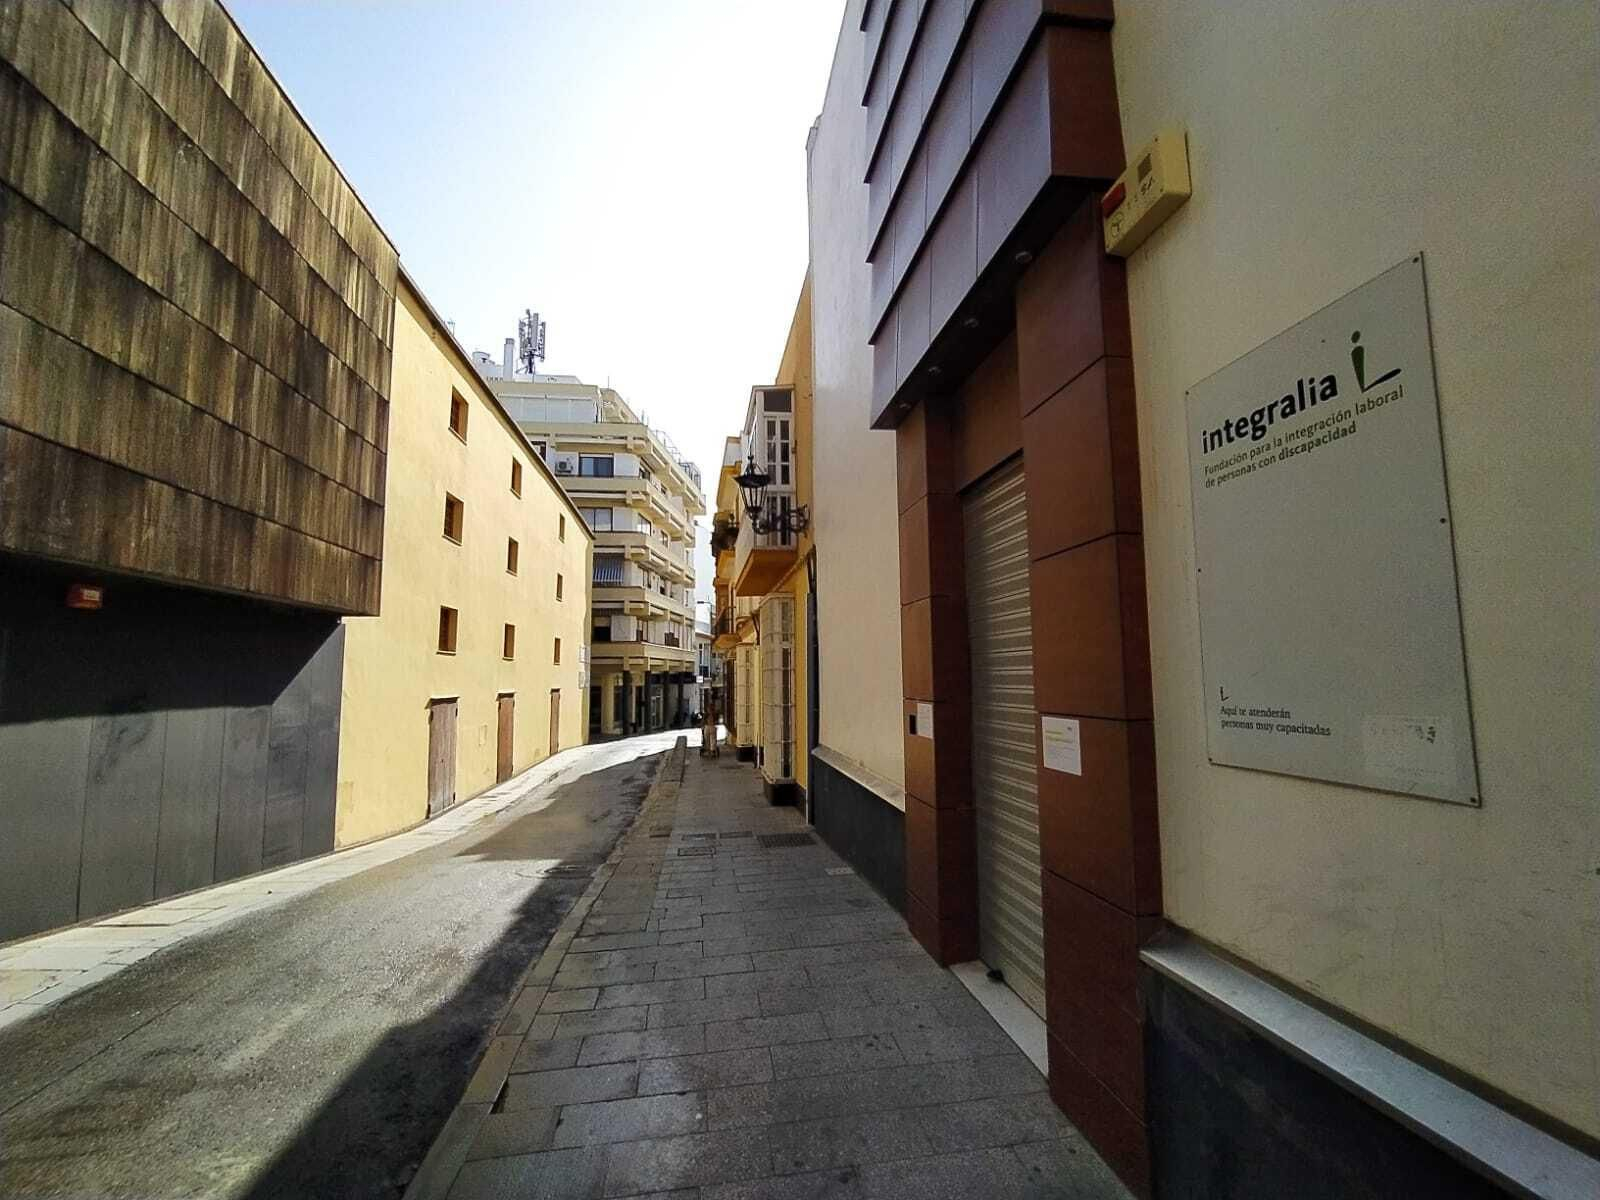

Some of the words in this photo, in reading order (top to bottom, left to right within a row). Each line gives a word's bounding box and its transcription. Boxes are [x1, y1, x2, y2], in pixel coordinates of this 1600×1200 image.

[1202, 374, 1338, 454] integralia
[1204, 452, 1248, 476] Fundación
[1250, 442, 1272, 458] para
[1273, 437, 1282, 448] la
[1285, 408, 1352, 444] integración
[1355, 384, 1403, 416] laboral
[1205, 478, 1216, 489] de
[1217, 463, 1257, 486] personas
[1258, 455, 1276, 469] con
[1279, 421, 1357, 460] discapacidad
[1221, 705, 1237, 717] Aquí
[1239, 708, 1247, 716] te
[1249, 707, 1292, 719] atenderán
[1221, 719, 1254, 730] personas
[1255, 722, 1274, 734] muy
[1276, 723, 1331, 736] capacitadas
